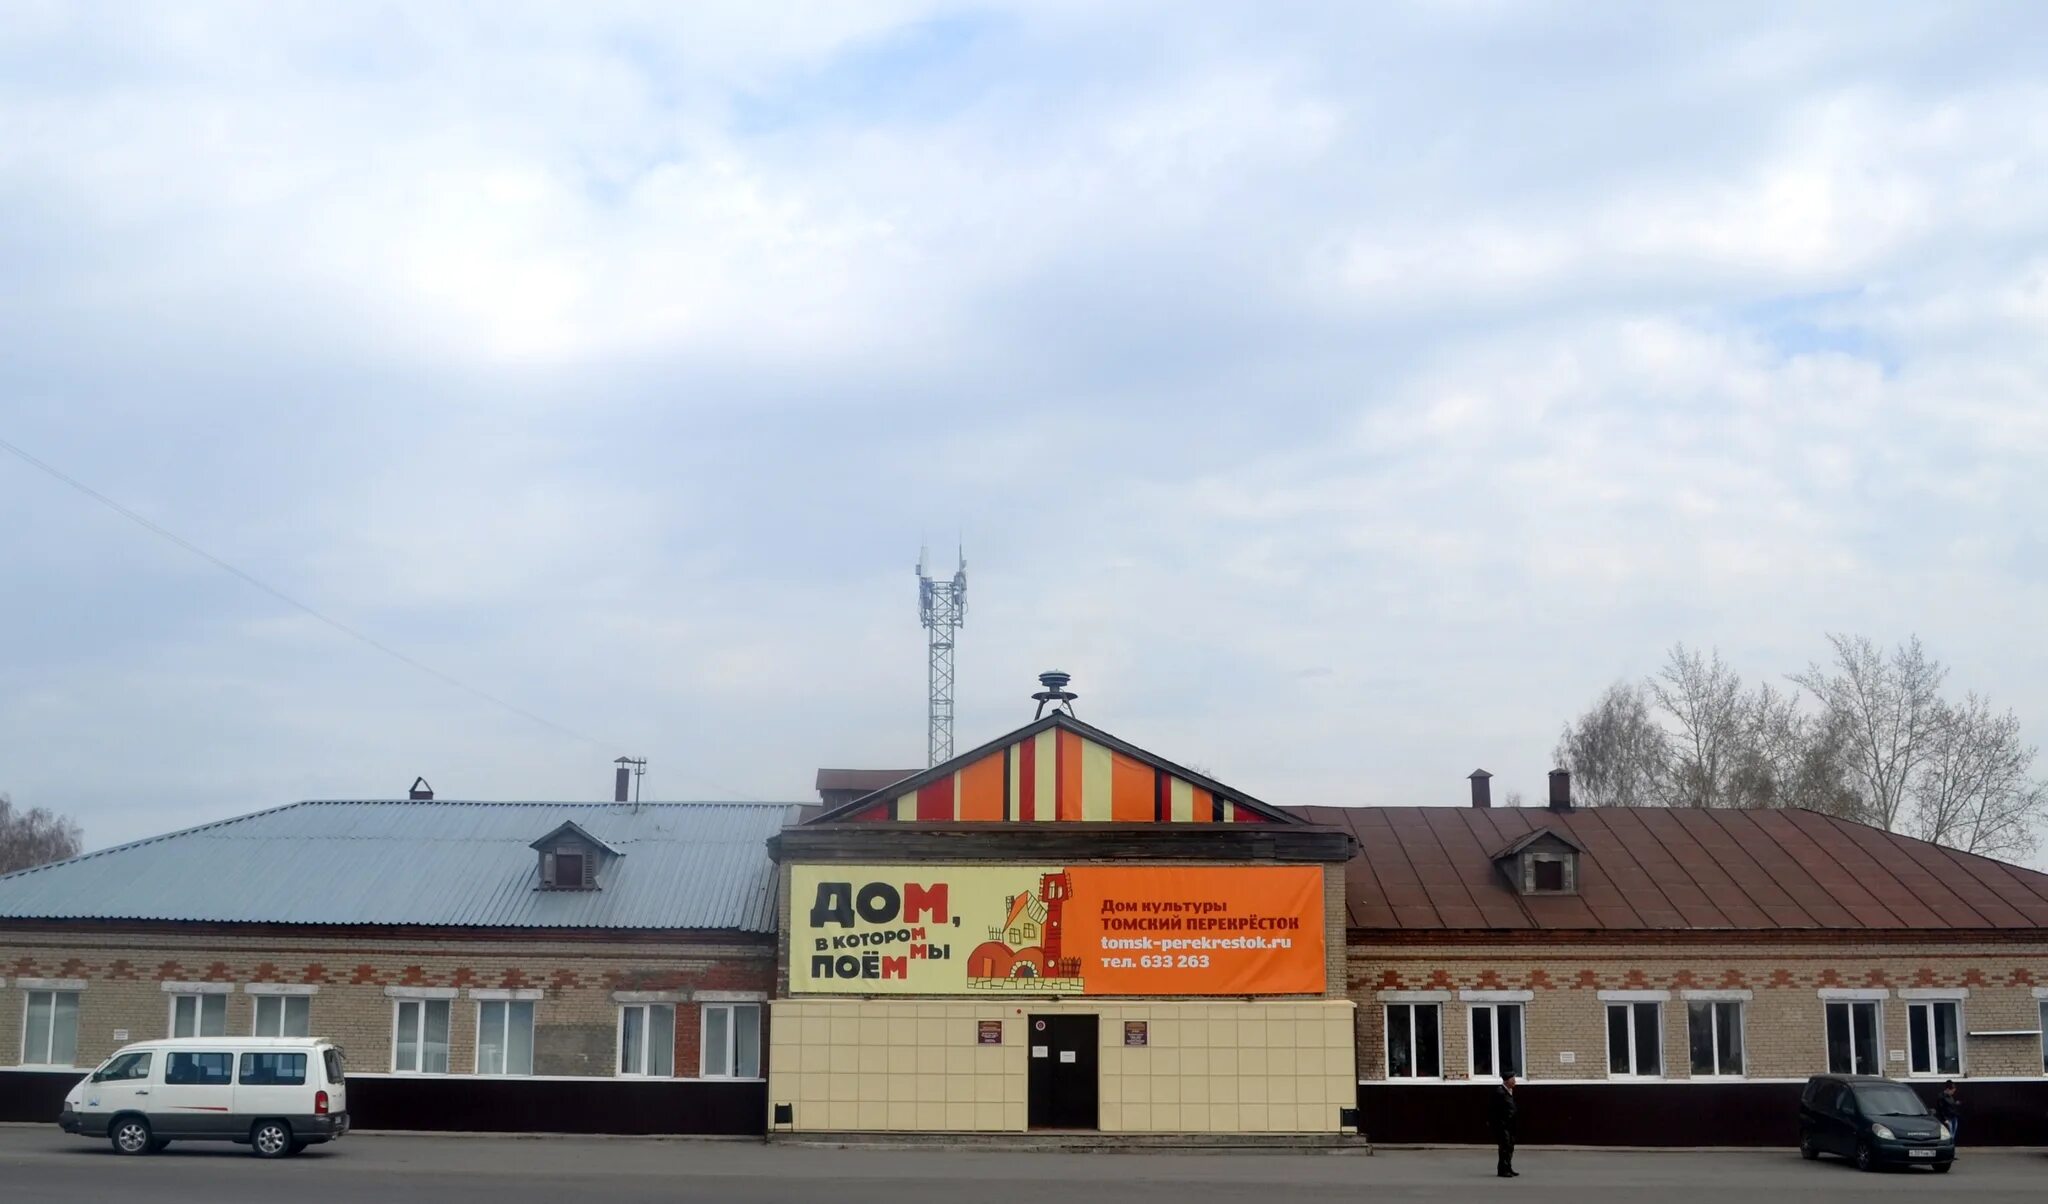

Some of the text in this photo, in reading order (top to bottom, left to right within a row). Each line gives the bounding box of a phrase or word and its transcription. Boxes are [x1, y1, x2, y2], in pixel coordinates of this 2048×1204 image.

[810, 882, 961, 928] ДОМ,
[1101, 899, 1227, 915] Дом культуры
[1101, 914, 1299, 931] ТОМСКИЙ ПЕРЕКРЁСТОК
[1101, 936, 1292, 951] tomsk-perekrestok.ru
[811, 951, 907, 979] ПОЁМ
[1101, 955, 1210, 968] тел. 633 263
